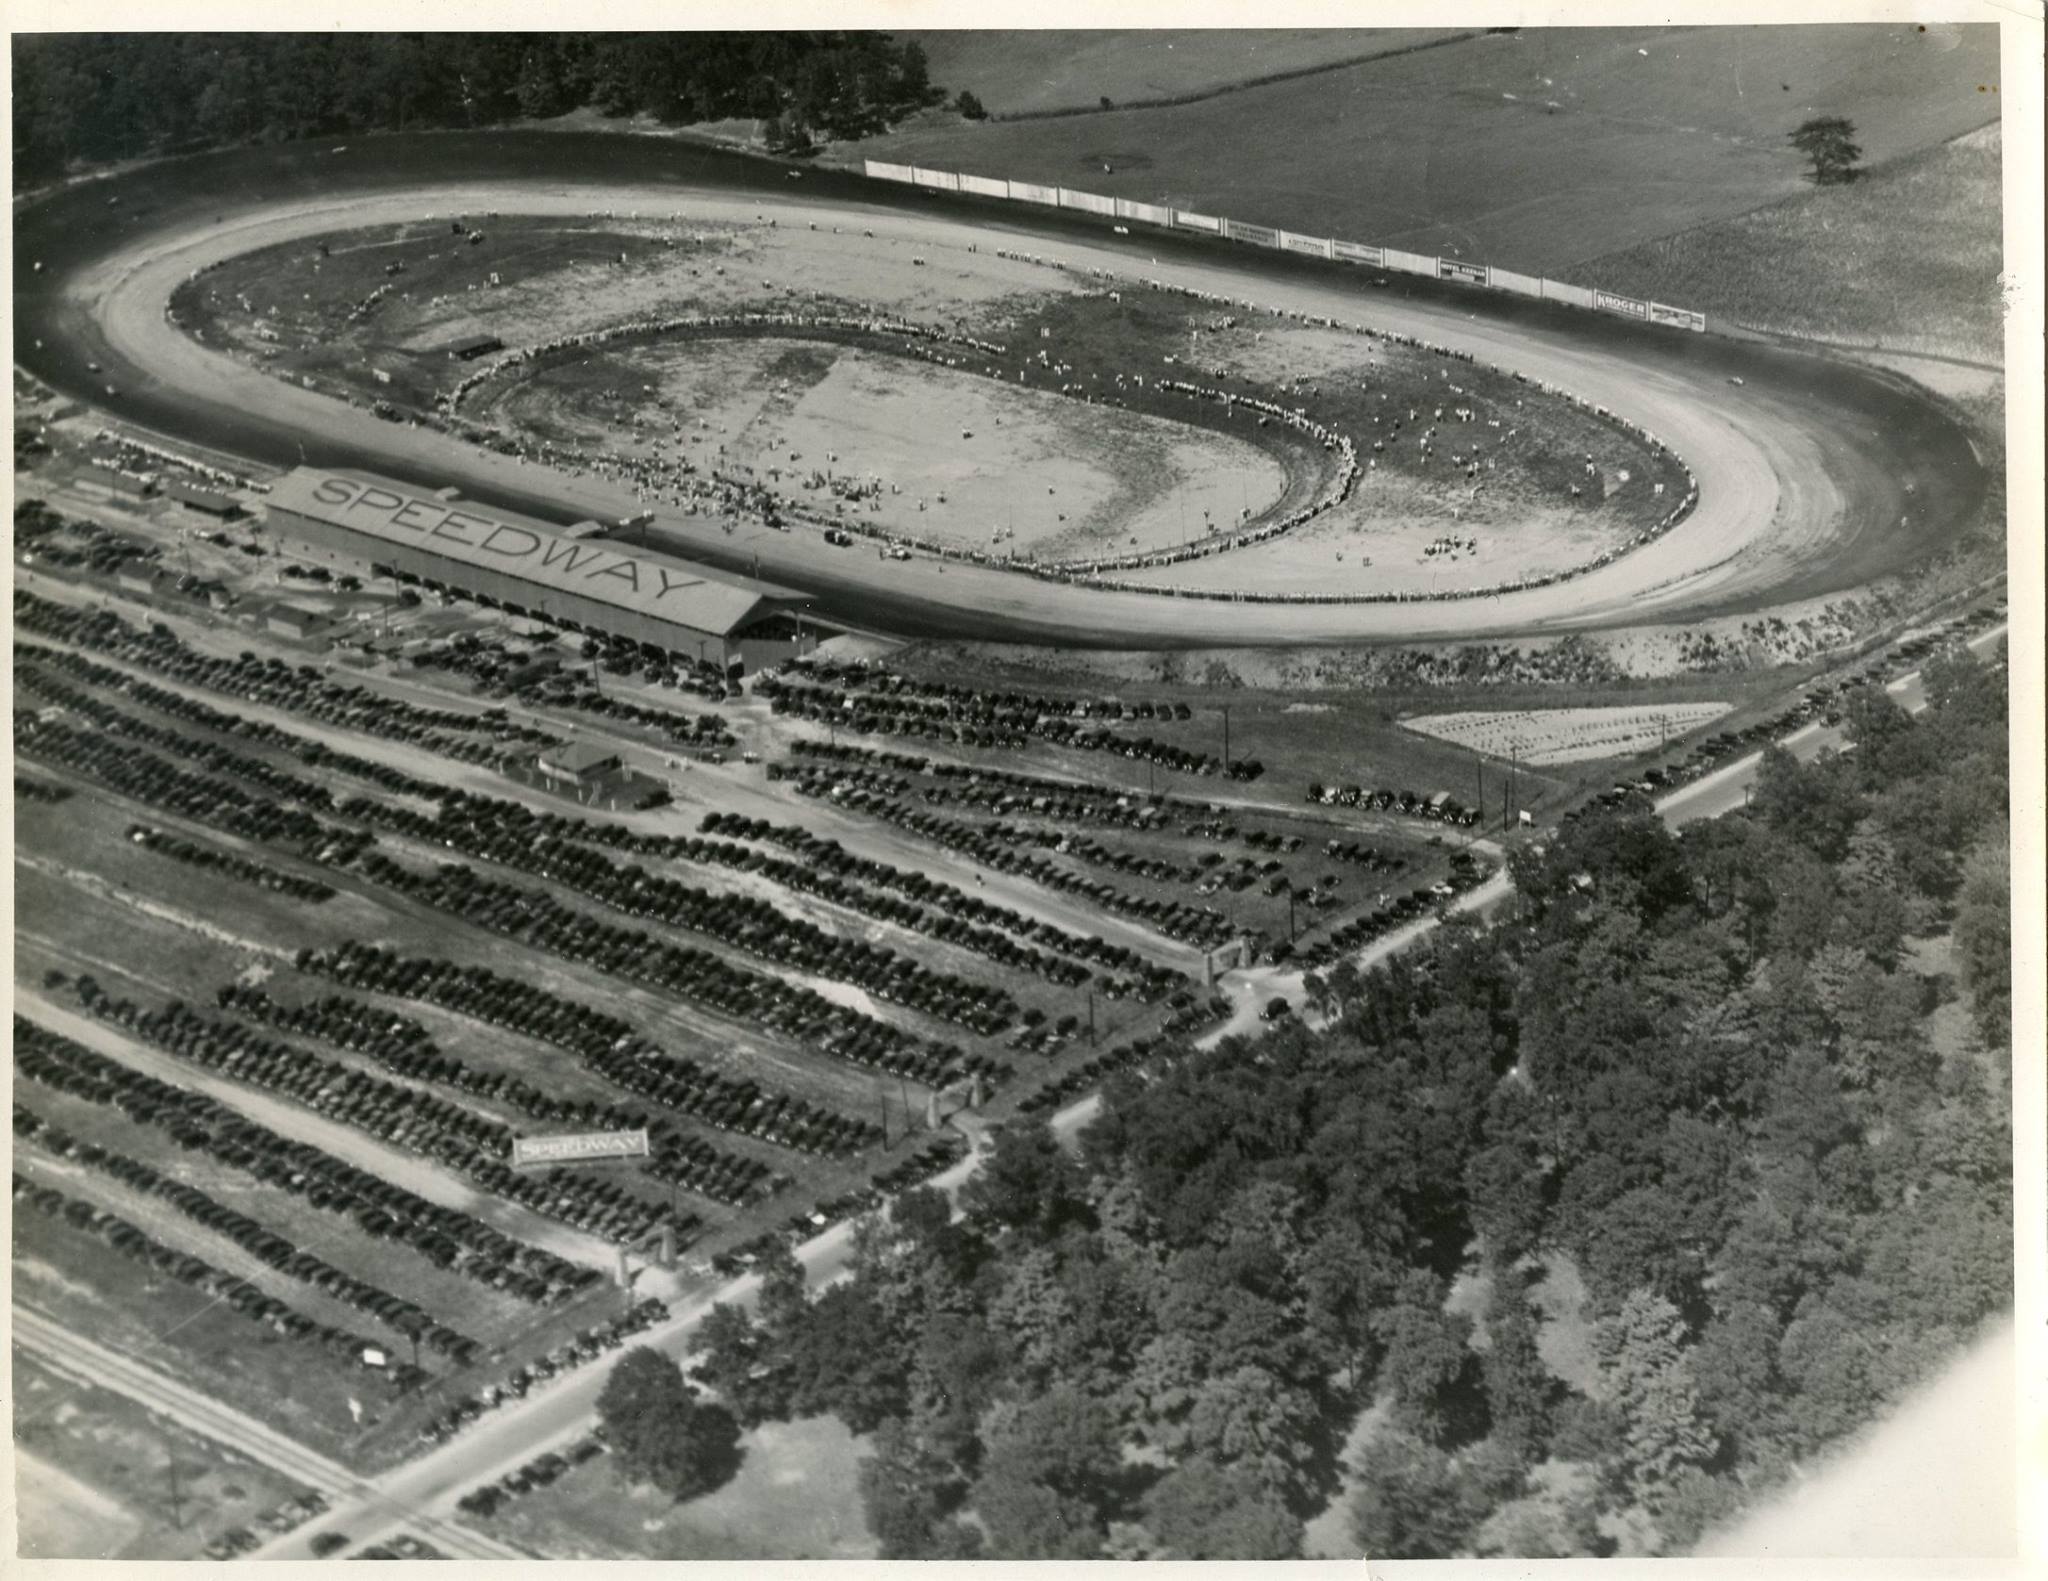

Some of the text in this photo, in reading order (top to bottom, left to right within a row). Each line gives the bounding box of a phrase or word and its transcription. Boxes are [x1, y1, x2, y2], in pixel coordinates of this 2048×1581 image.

[1597, 294, 1645, 313] KROGER
[312, 477, 707, 599] SPEEDWAY
[521, 1136, 638, 1155] SPEEDWAY
